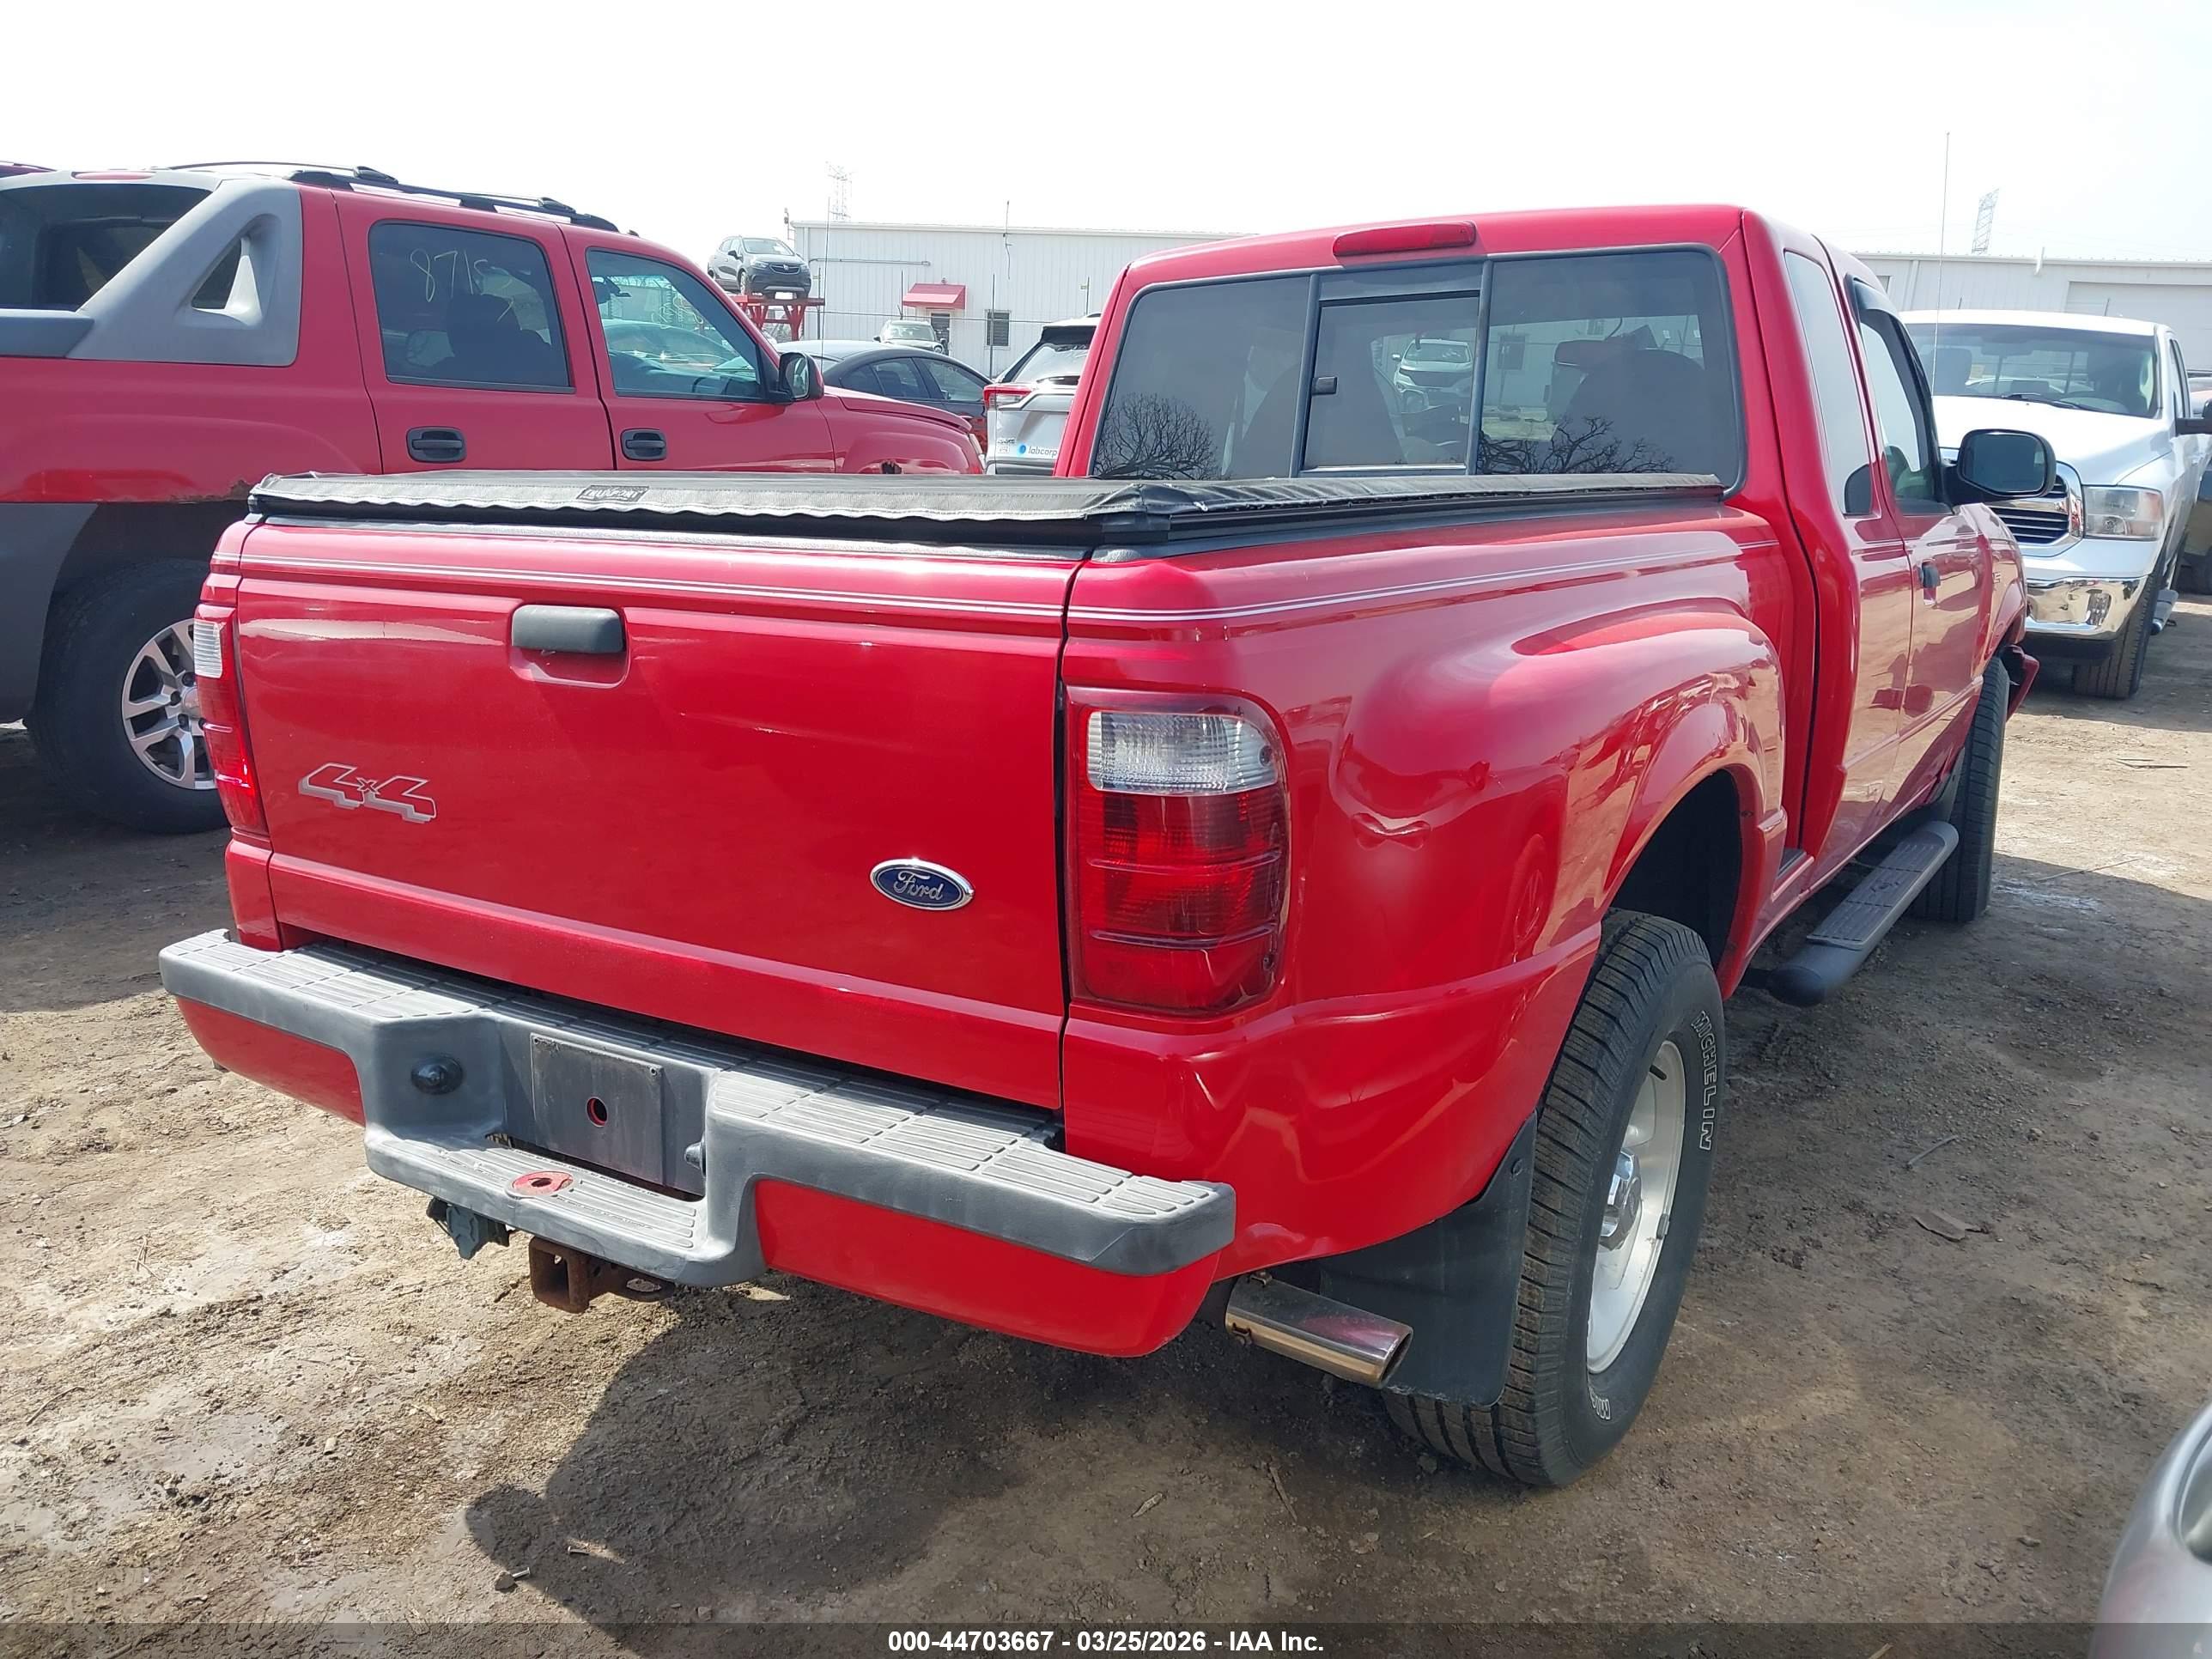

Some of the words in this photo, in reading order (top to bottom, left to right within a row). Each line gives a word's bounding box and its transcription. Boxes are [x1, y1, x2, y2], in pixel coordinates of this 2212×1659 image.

[1028, 446, 1058, 458] labcorp
[893, 870, 945, 901] Ford
[1691, 1010, 1717, 1151] MICHELIN
